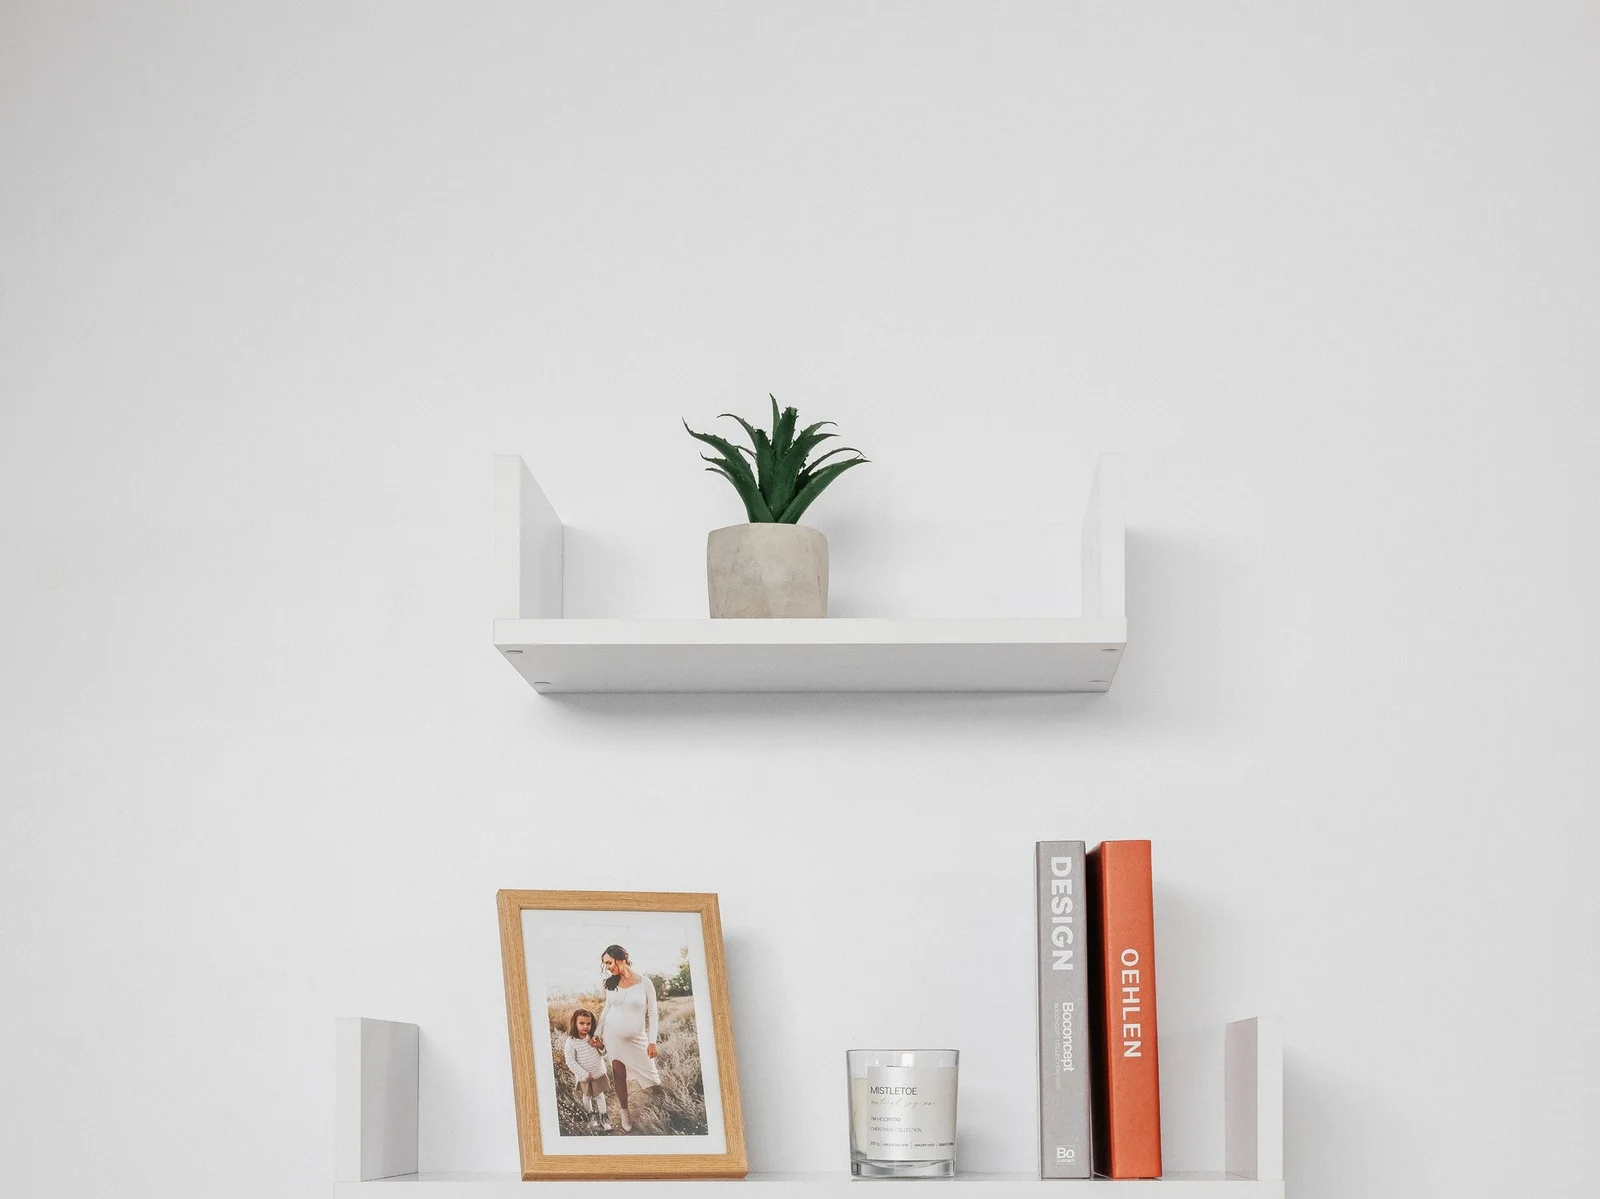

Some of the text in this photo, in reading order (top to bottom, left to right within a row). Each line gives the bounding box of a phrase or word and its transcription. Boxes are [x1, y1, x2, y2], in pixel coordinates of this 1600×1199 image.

[1050, 856, 1074, 971] DESIGN
[1061, 1002, 1075, 1072] Boconcept
[1121, 948, 1142, 1058] OEHLEN
[870, 1086, 918, 1095] MISTLETOE
[1056, 1147, 1075, 1159] Bo
